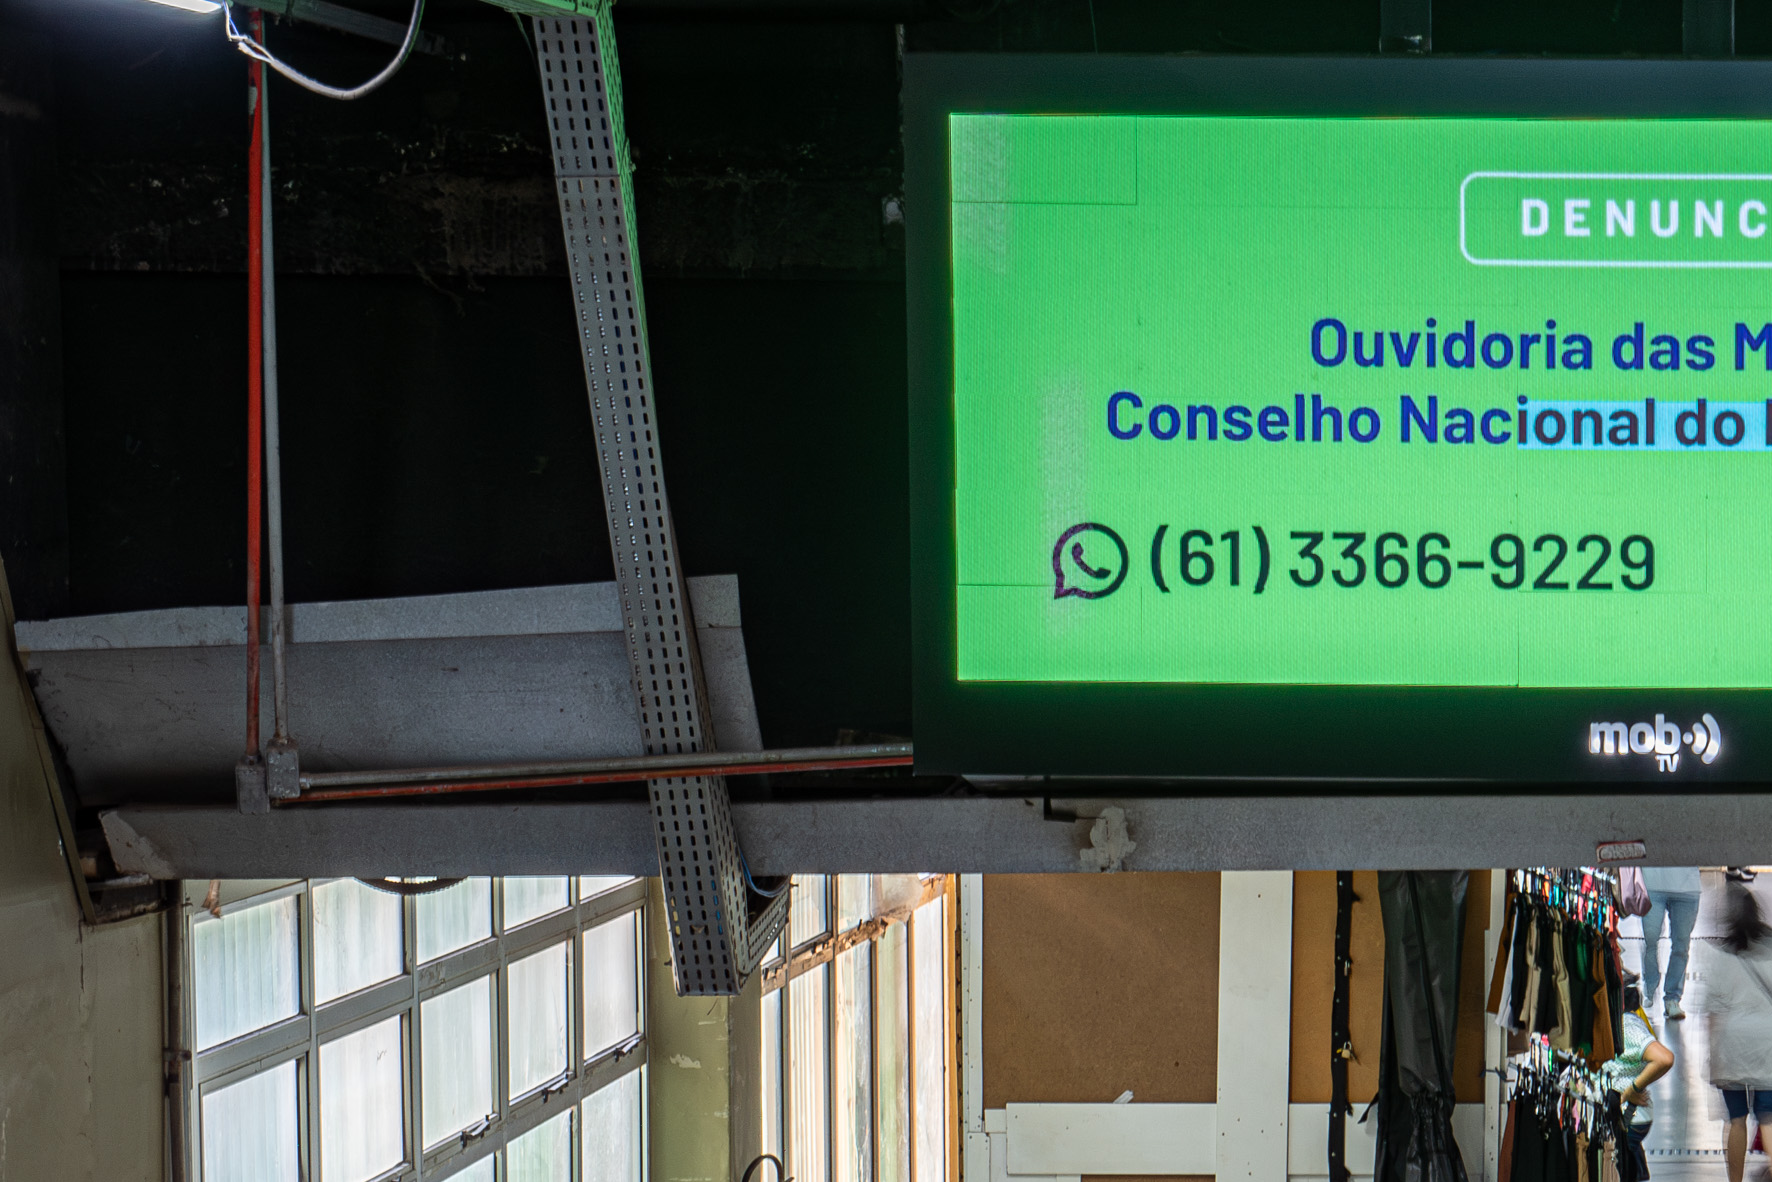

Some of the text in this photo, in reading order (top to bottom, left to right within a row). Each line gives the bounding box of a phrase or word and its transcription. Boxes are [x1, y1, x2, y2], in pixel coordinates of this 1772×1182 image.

[1311, 317, 1593, 370] Ouvidoria
[1611, 321, 1716, 371] das
[1107, 390, 1381, 444] Conselho
[1400, 394, 1656, 446] Nacional
[1674, 397, 1746, 447] do
[1150, 524, 1655, 594] (61) 3366-9229
[1588, 713, 1681, 755] mob
[1655, 754, 1681, 773] TV
